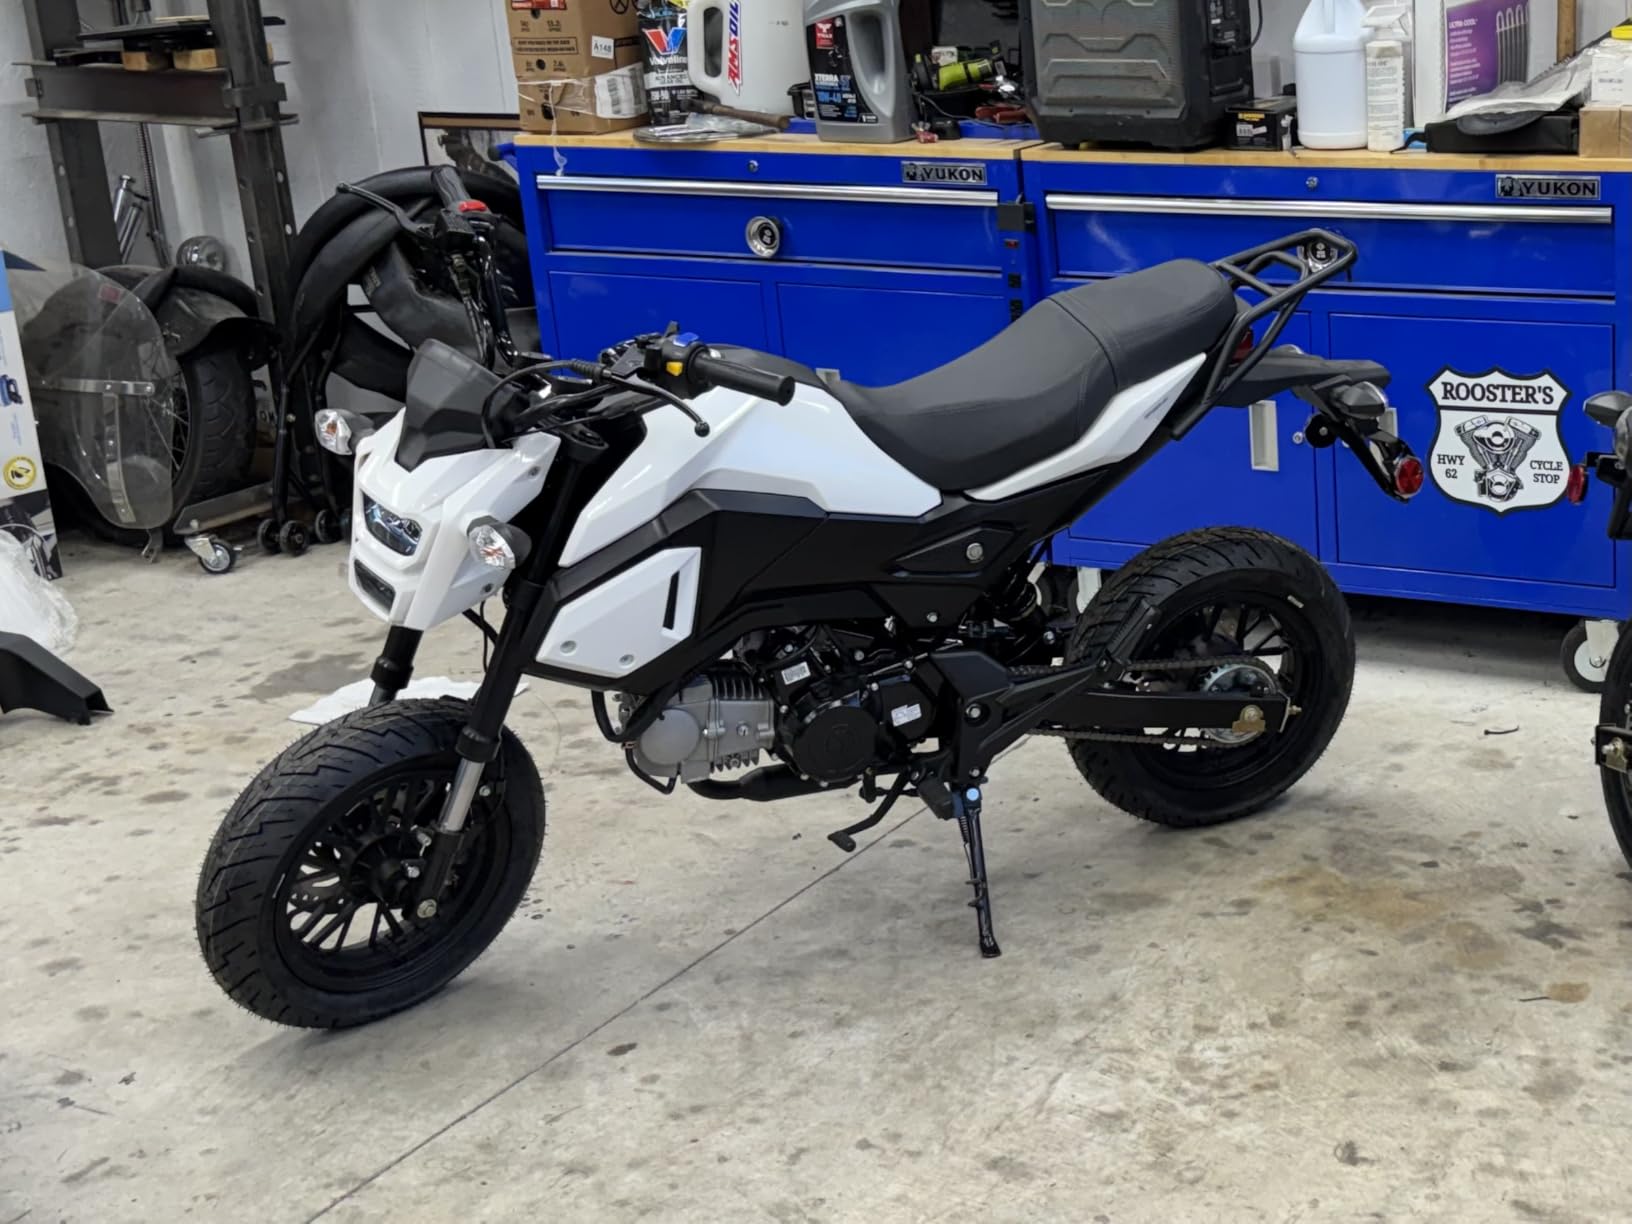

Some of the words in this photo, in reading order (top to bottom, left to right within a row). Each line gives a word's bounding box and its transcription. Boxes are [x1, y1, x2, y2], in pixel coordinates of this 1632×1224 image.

[728, 1, 740, 90] AMSOIL
[649, 56, 688, 66] Valvoline
[922, 167, 983, 181] YUKON
[1522, 181, 1596, 196] YUKON
[1441, 381, 1555, 405] ROOSTER'S
[1437, 453, 1465, 466] HWY
[1529, 460, 1563, 471] CYCLE
[1445, 468, 1458, 479] 62
[1532, 473, 1560, 484] STOP
